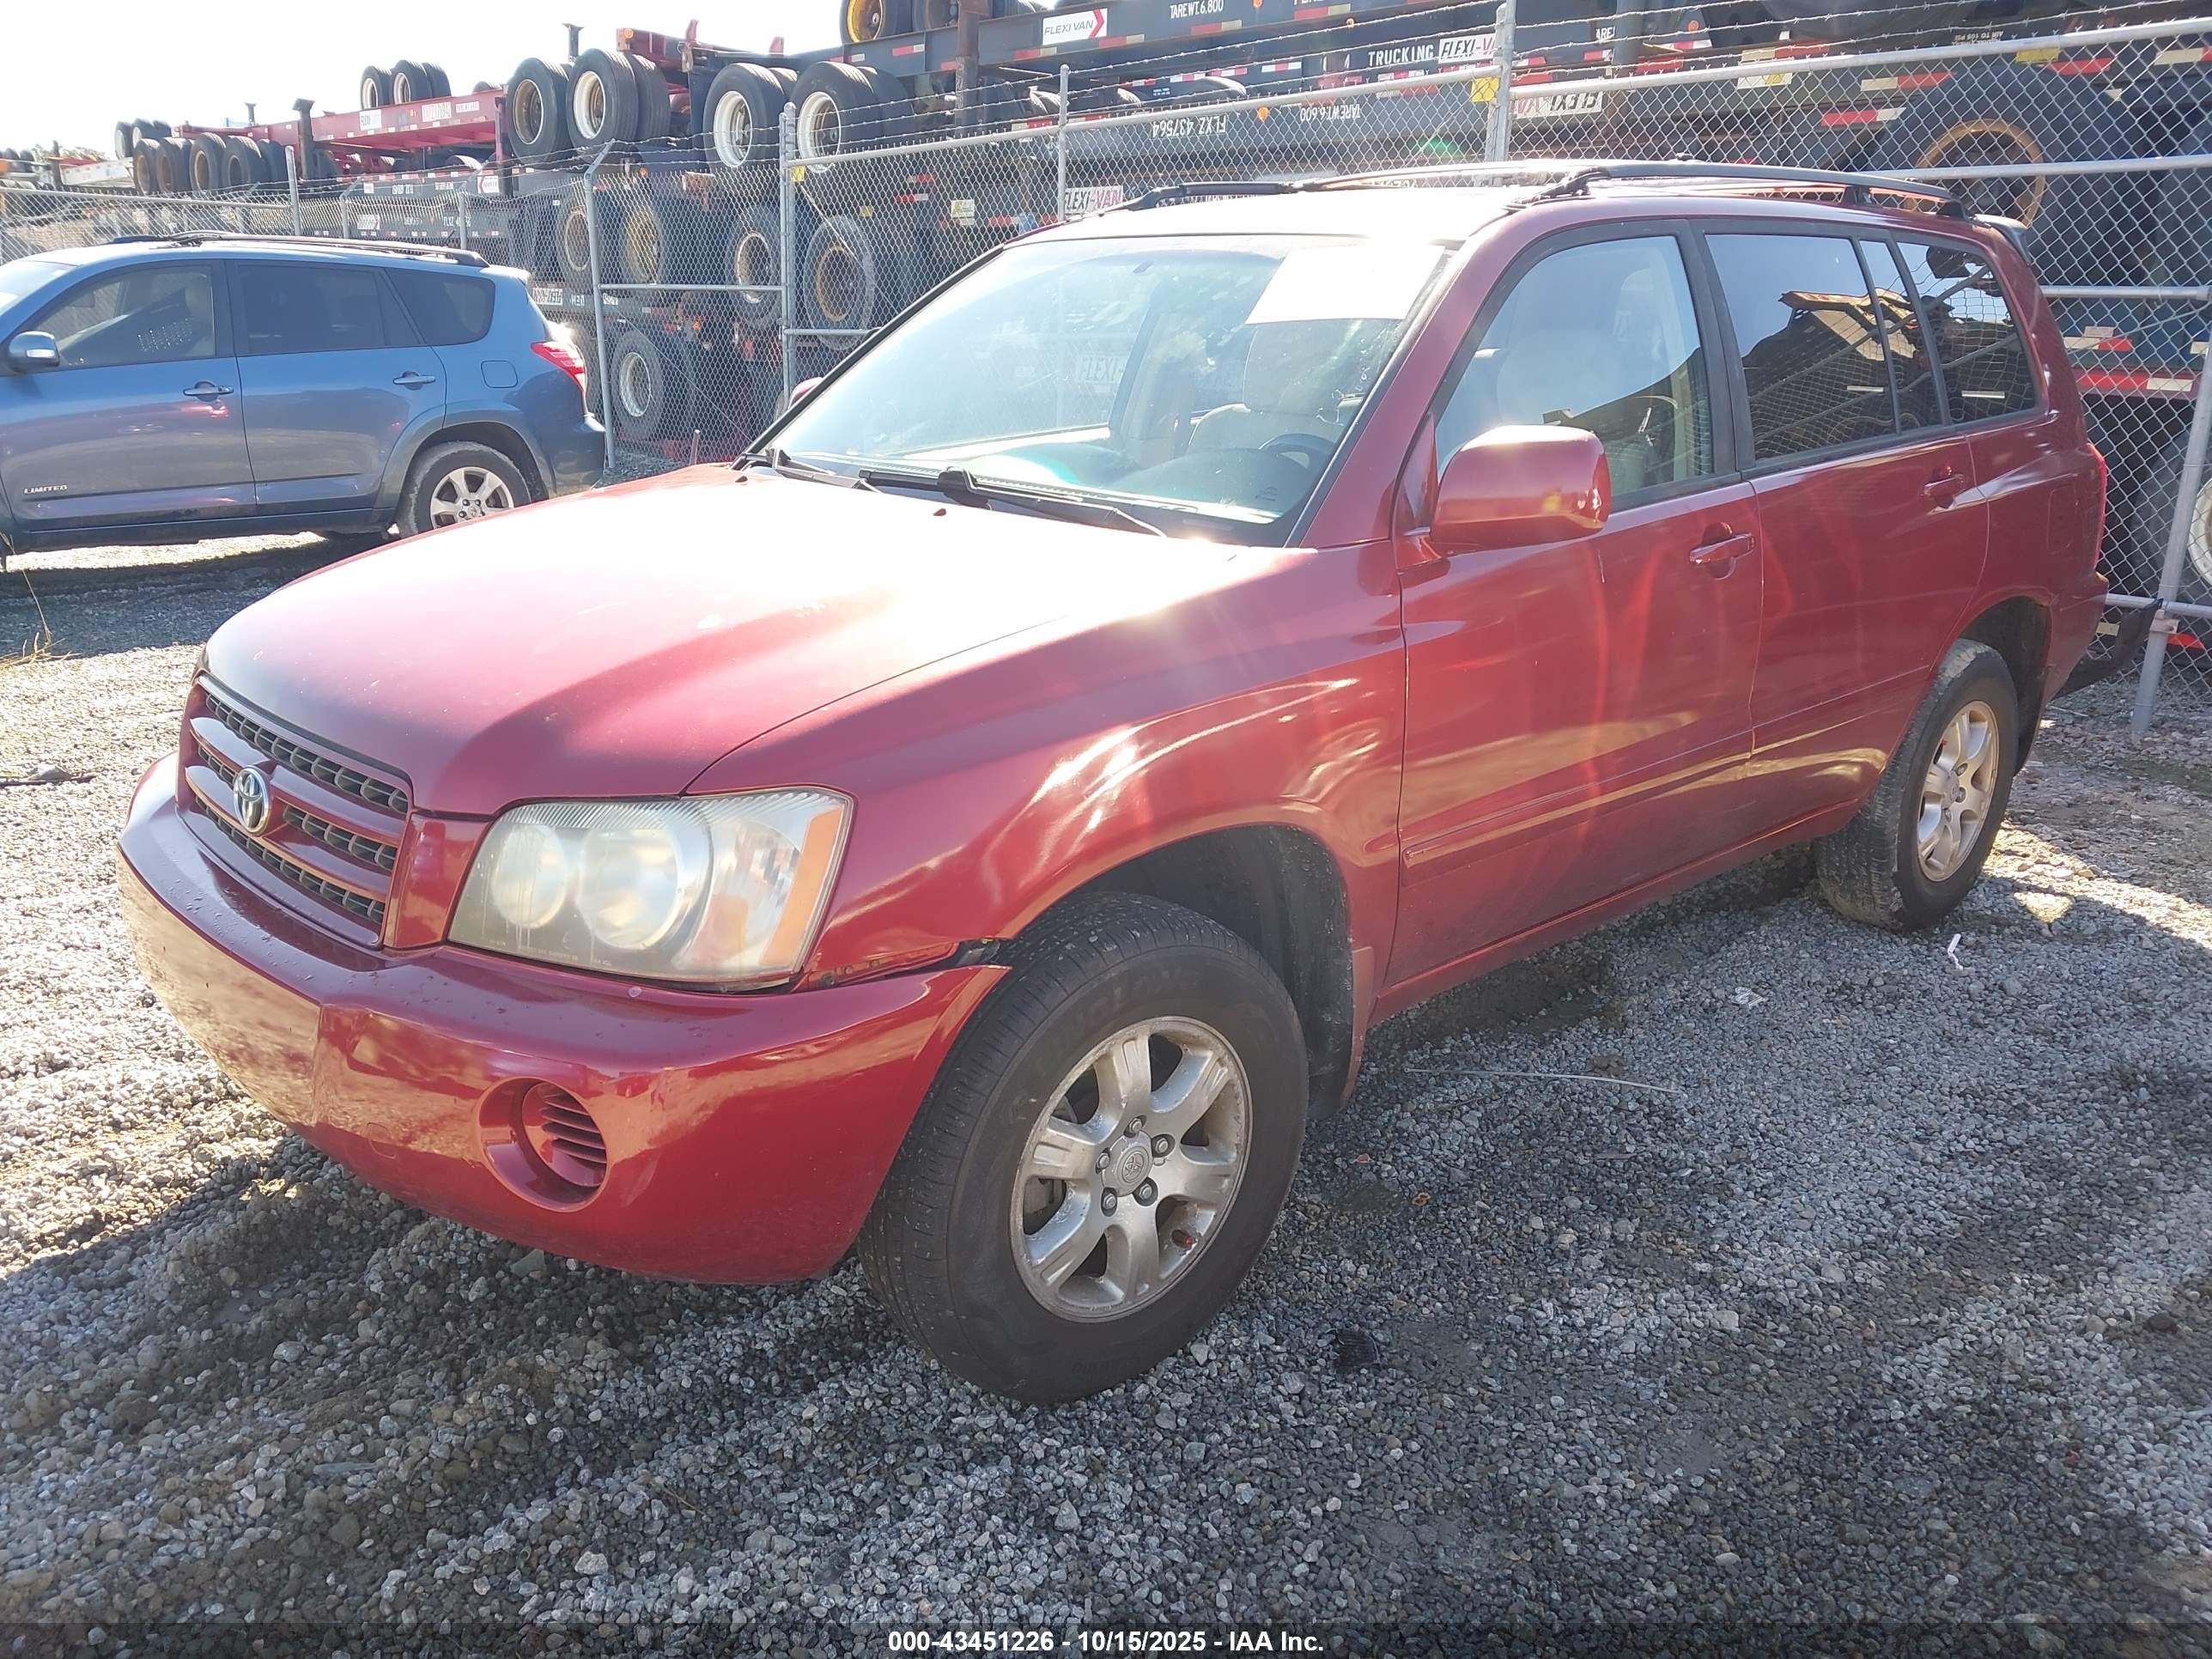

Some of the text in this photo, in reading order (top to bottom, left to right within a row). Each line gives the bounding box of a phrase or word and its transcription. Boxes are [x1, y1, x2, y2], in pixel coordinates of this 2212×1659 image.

[1044, 19, 1094, 35] FLEXI VAN
[1368, 45, 1434, 67] TRUCKING
[1152, 115, 1227, 138] FLXZ 437564
[24, 484, 68, 495] LIMITED
